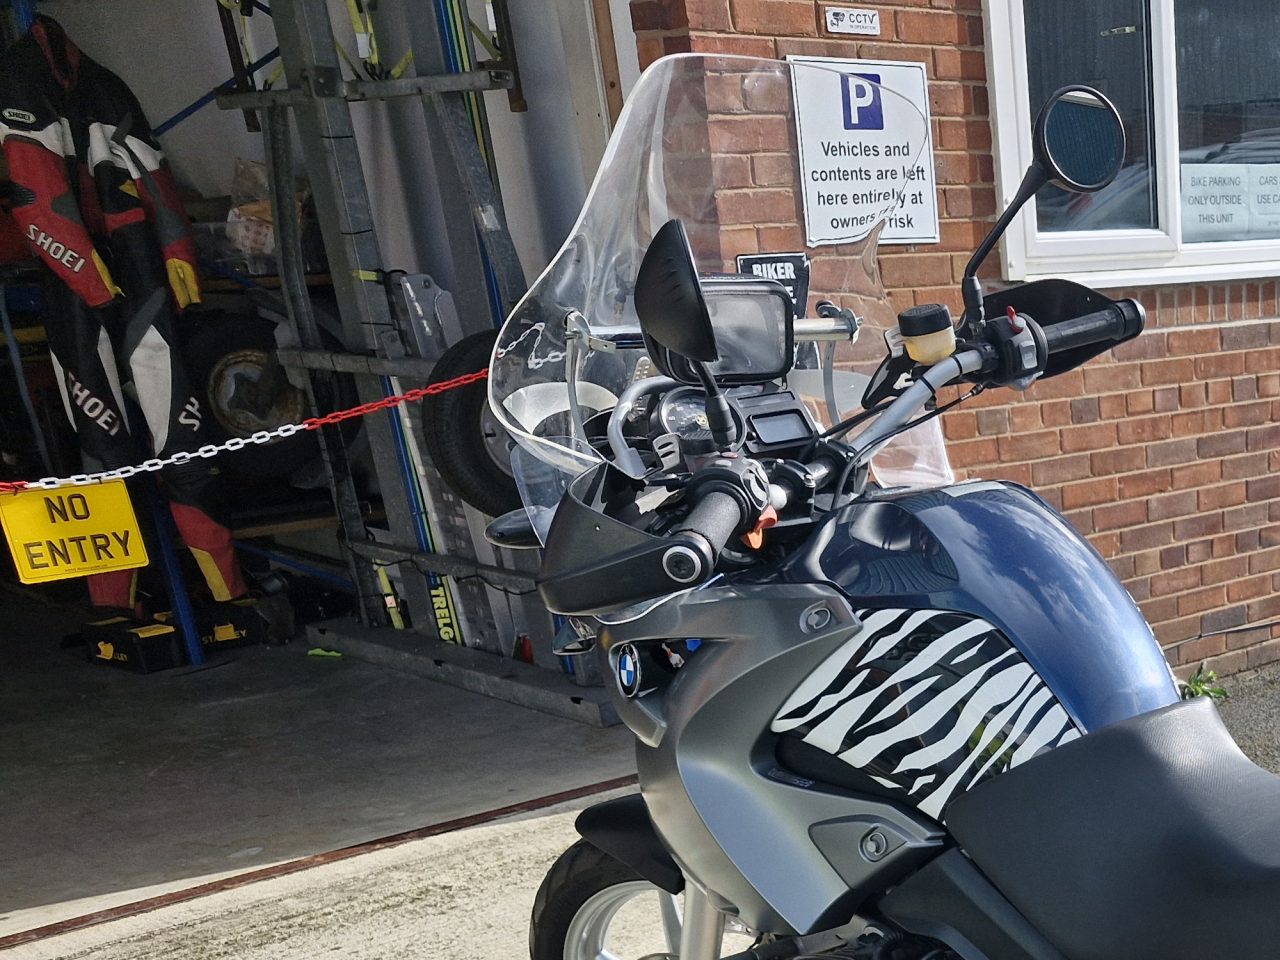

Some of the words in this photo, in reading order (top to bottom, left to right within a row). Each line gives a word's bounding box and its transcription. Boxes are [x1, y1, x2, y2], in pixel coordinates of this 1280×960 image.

[848, 13, 877, 24] CCTV
[848, 76, 874, 124] P
[7, 110, 31, 121] SHOEI
[820, 141, 880, 157] Vehicles
[884, 141, 910, 157] and
[811, 167, 872, 182] contents
[876, 169, 898, 180] are
[902, 165, 926, 181] left
[1190, 176, 1207, 187] BIKE
[1208, 176, 1241, 187] PARKING
[1259, 176, 1279, 186] CARS
[817, 191, 848, 206] here
[852, 187, 906, 208] entirely
[910, 191, 923, 204] at
[1187, 195, 1209, 205] ONLY
[1209, 195, 1241, 205] OUTSIDE
[1256, 194, 1271, 204] USE
[830, 212, 875, 229] owners
[888, 214, 914, 228] risk
[1198, 214, 1215, 224] THIS
[1216, 213, 1233, 224] UNIT
[25, 224, 86, 273] SHOEI
[751, 262, 796, 280] BIKER
[43, 493, 91, 523] NO
[23, 530, 130, 570] ENTRY
[202, 628, 247, 645] STEY
